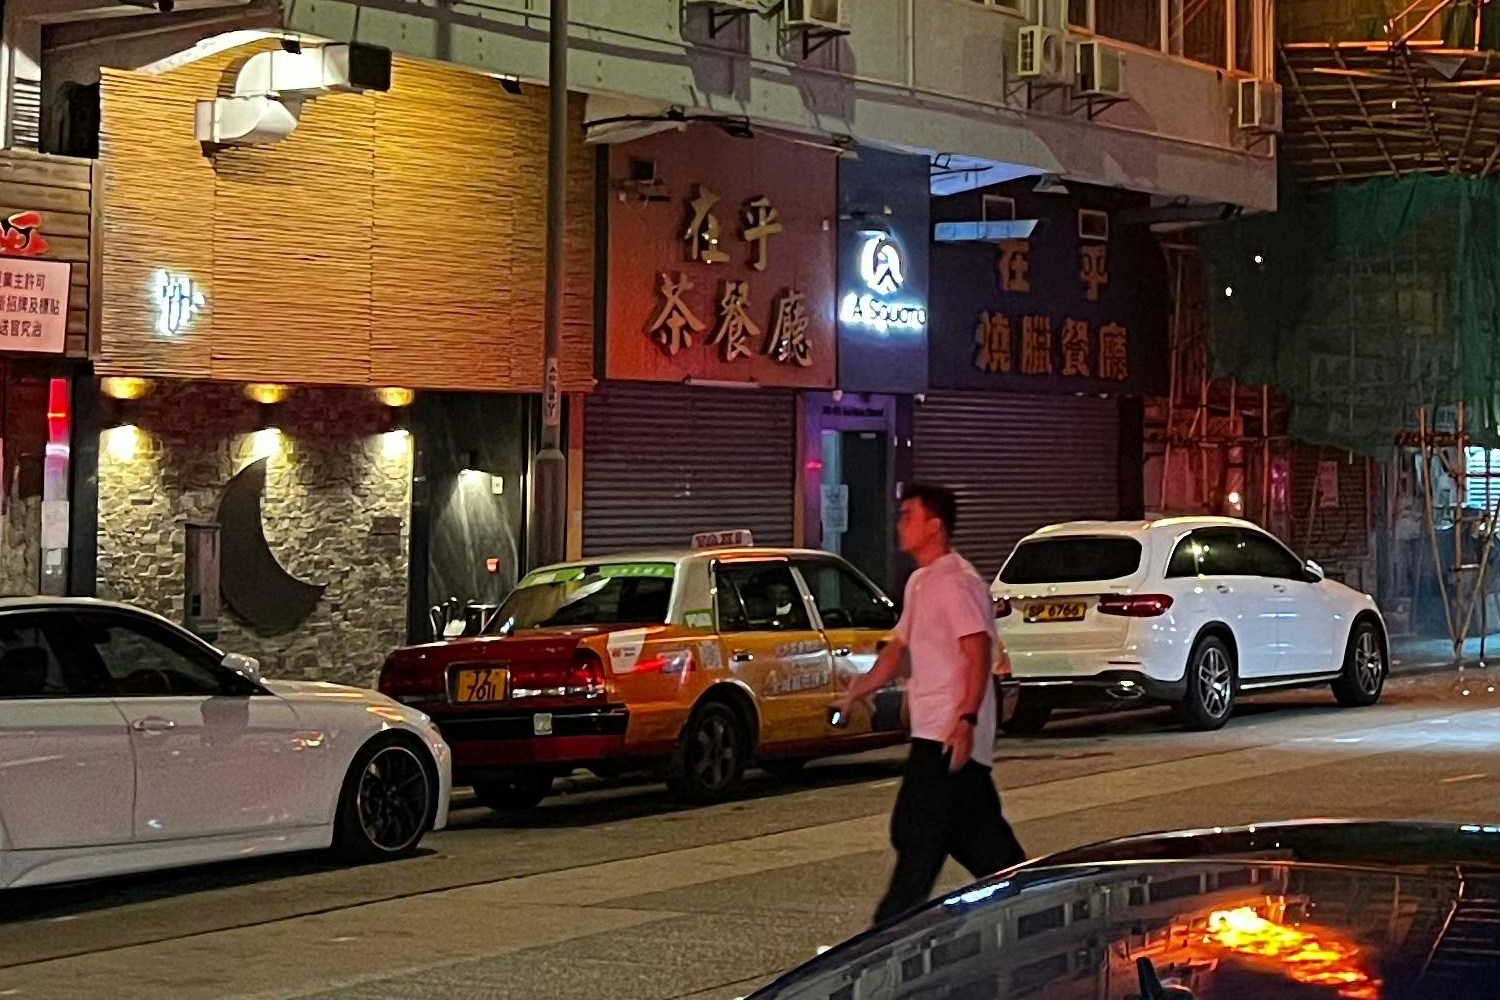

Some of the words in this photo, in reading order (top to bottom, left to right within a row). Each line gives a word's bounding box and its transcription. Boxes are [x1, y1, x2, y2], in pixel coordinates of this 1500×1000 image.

[684, 186, 783, 272] 在乎
[650, 272, 814, 367] 茶餐廳
[696, 531, 742, 547] TAXI
